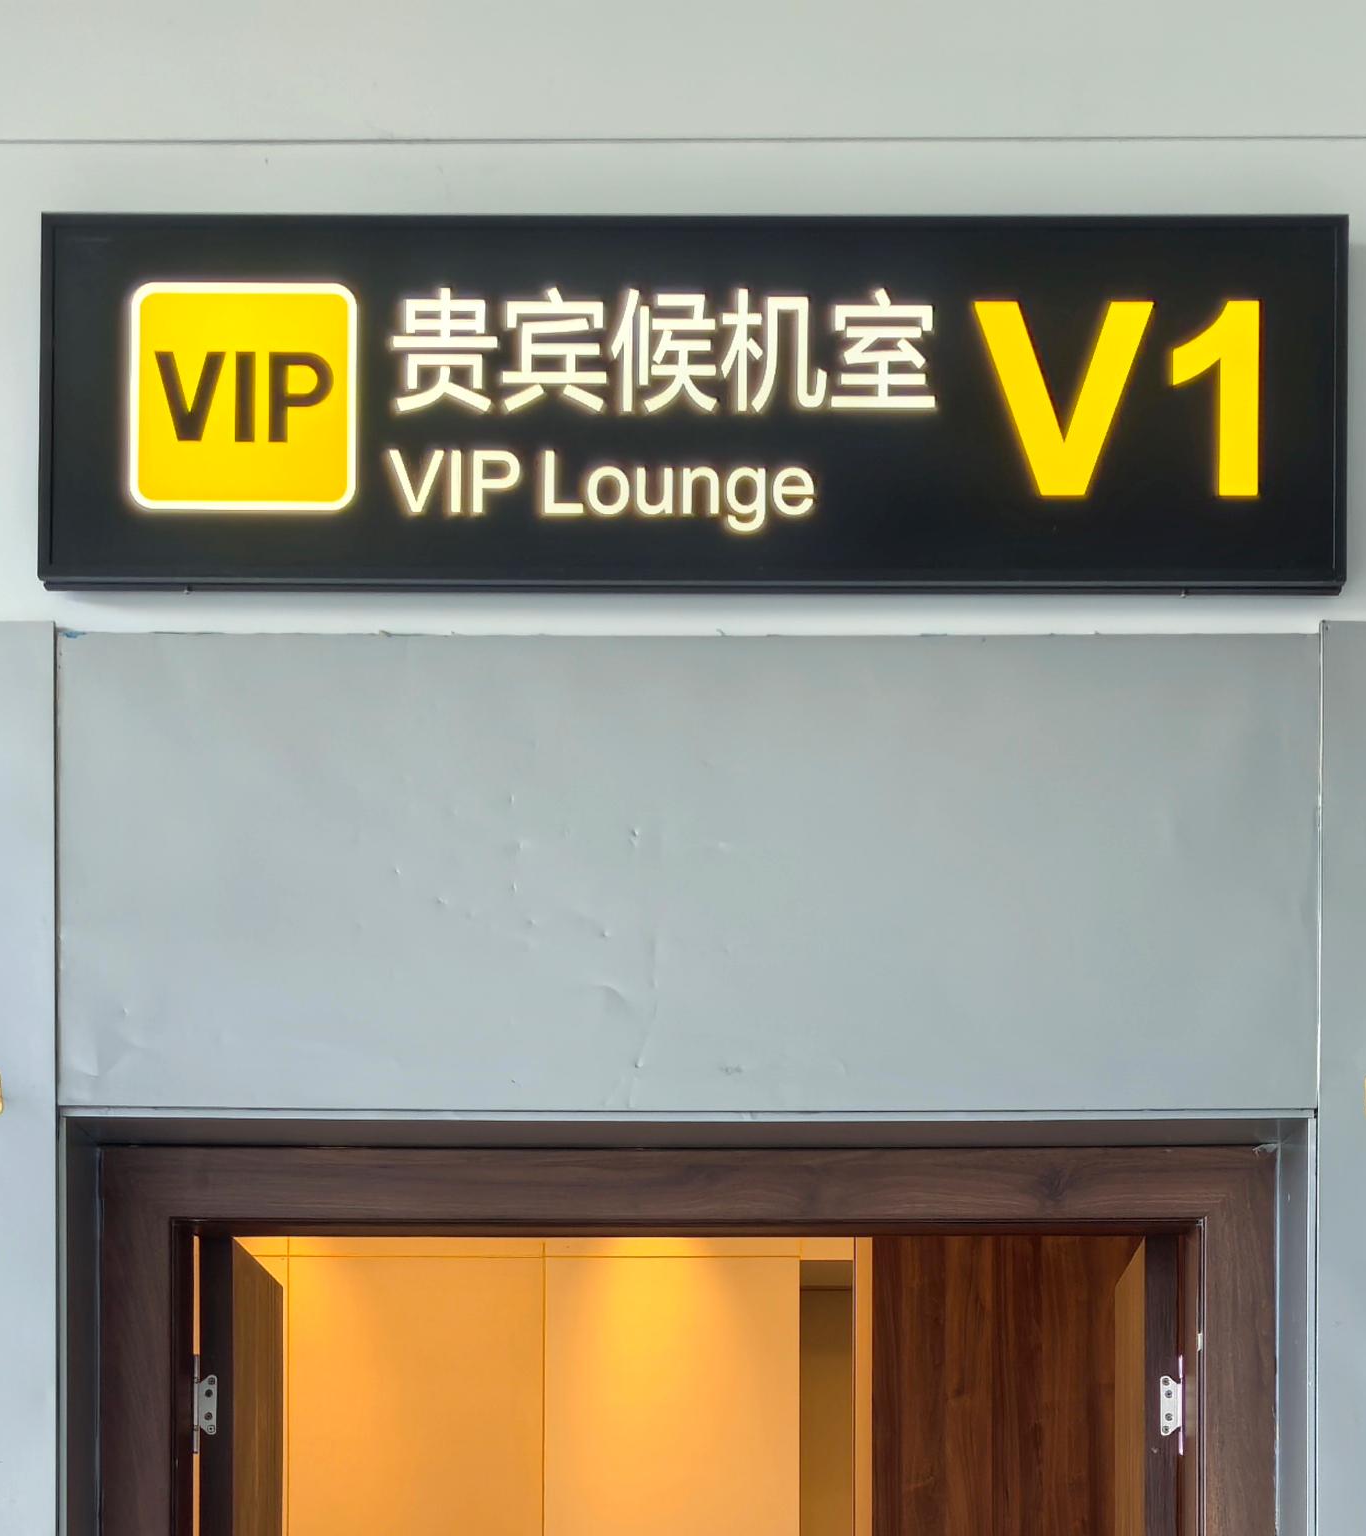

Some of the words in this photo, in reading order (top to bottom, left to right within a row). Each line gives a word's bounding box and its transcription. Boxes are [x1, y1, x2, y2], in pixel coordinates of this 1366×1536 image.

[153, 351, 335, 443] VIP
[390, 288, 937, 414] 贵宾候机室
[973, 298, 1261, 498] V1
[388, 449, 522, 516] VIP
[541, 450, 816, 534] Lounge
